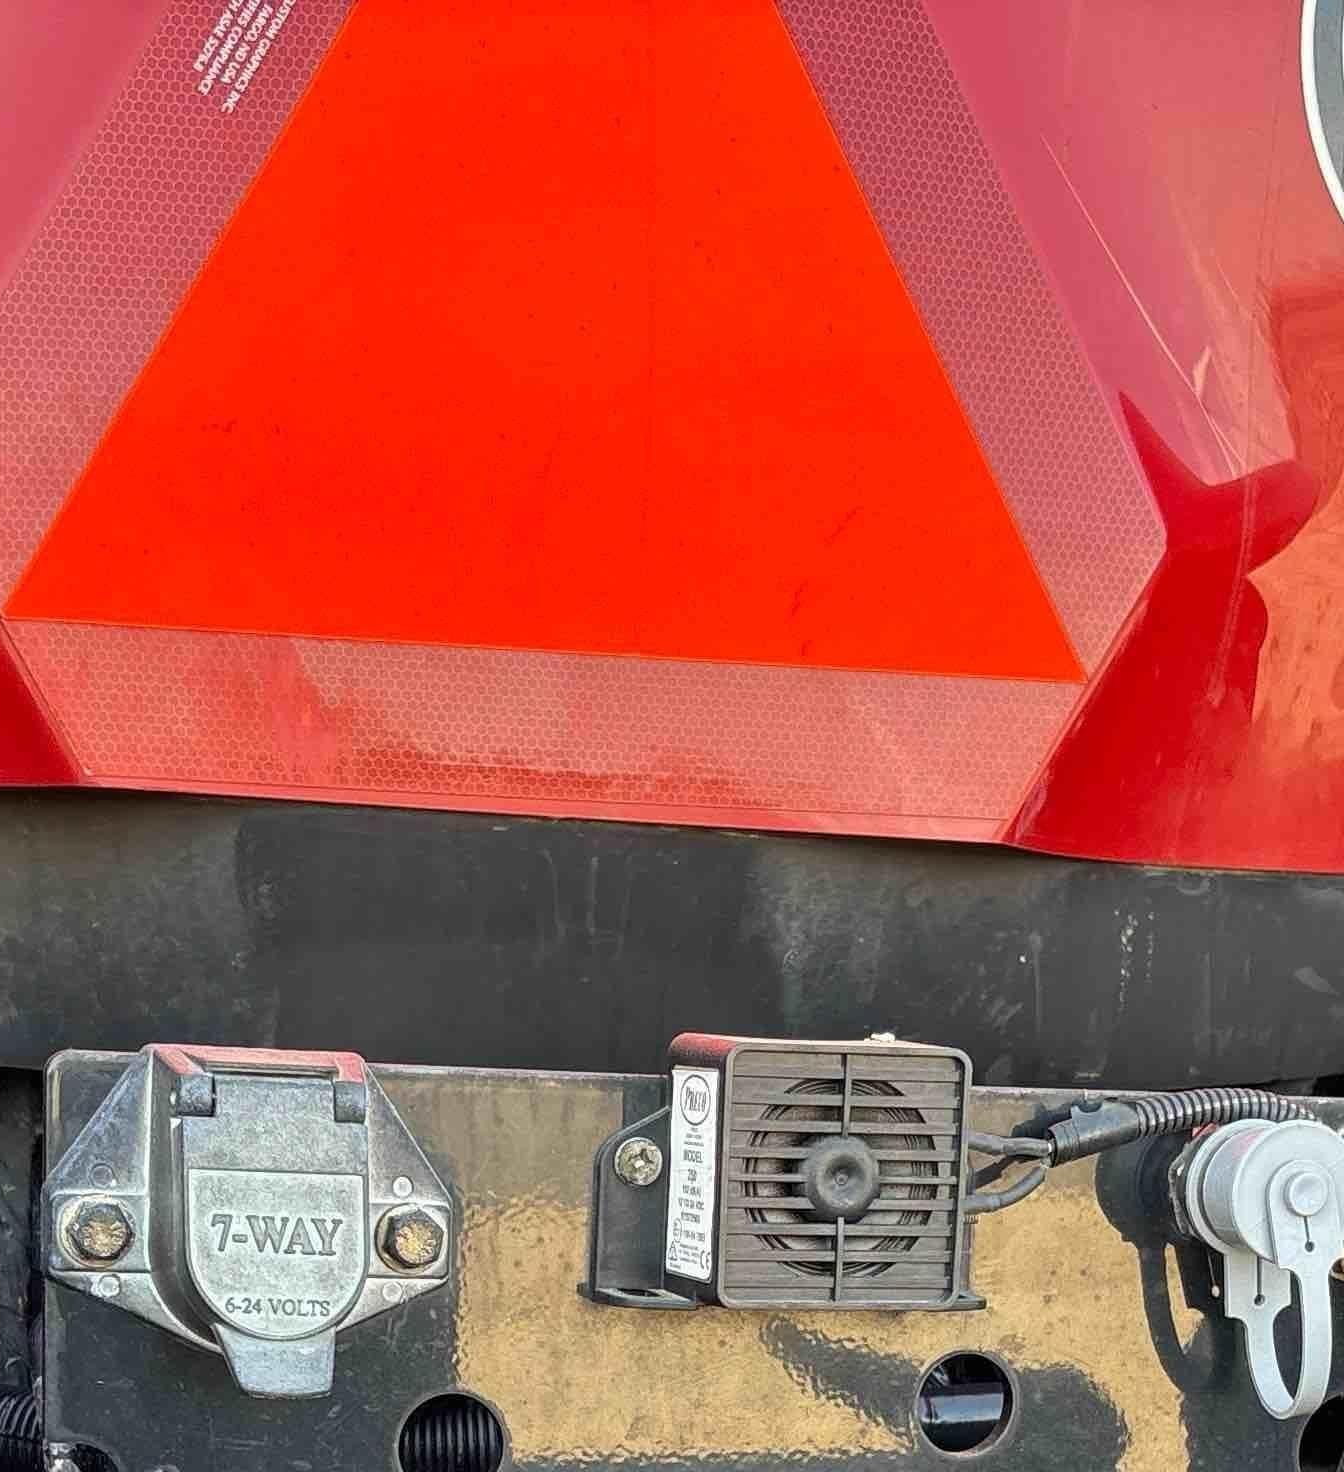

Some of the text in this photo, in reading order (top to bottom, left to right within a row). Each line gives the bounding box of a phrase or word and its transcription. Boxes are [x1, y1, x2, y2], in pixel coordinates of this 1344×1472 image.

[198, 26, 243, 96] COMPLIANCE
[220, 62, 241, 84] USA
[235, 38, 271, 92] GRAPHICS
[210, 1213, 344, 1257] 7-WAY
[224, 1297, 332, 1318] 6-24 VOLTS
